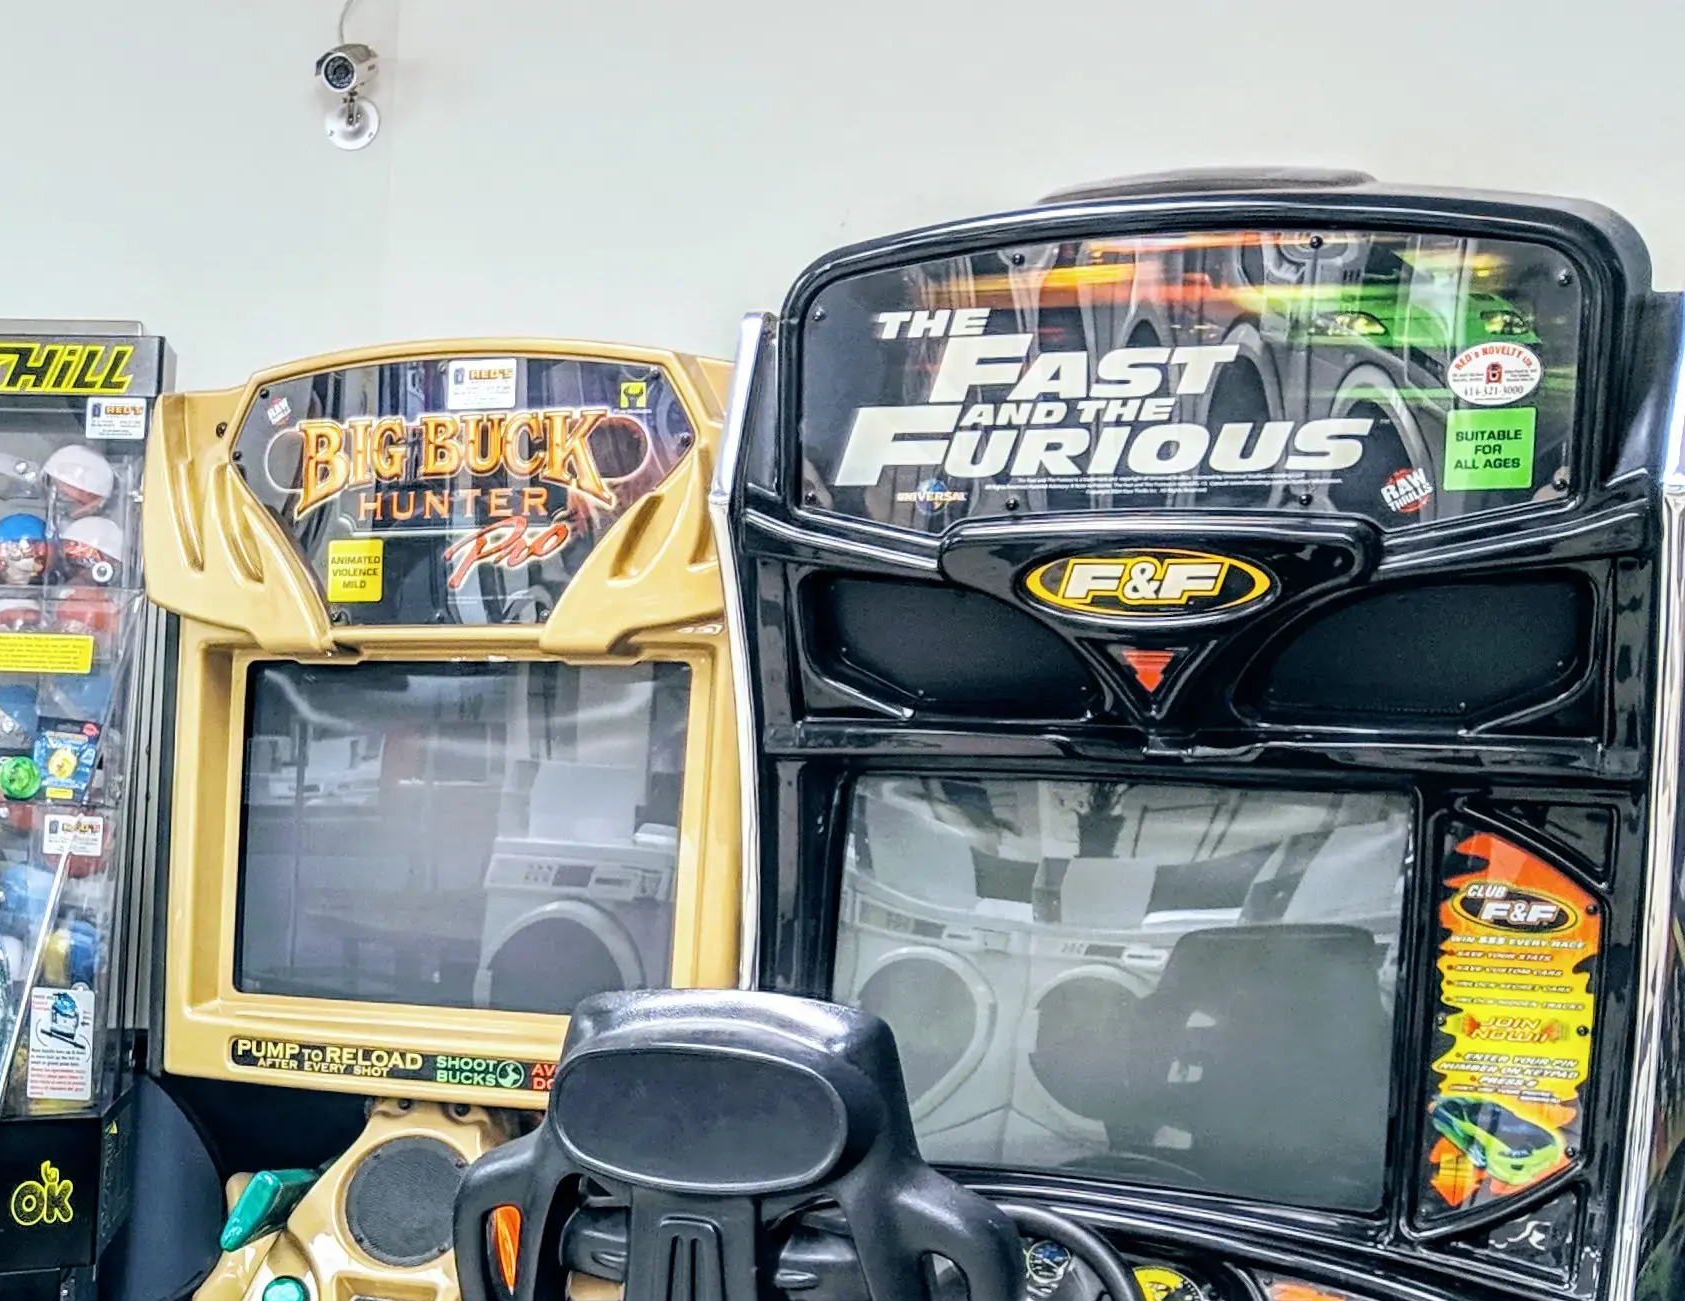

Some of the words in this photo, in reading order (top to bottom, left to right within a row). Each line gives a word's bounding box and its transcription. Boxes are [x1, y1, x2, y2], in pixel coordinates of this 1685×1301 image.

[877, 307, 991, 340] THE
[928, 332, 1241, 403] FAST
[958, 397, 1073, 424] AND
[1078, 396, 1176, 422] THE
[1454, 430, 1524, 442] SUITABLE
[834, 404, 1375, 486] FURIOUS
[1474, 444, 1503, 456] FOR
[294, 418, 412, 519] BIG
[417, 408, 616, 509] BUCK
[1454, 458, 1479, 470] ALL
[1482, 457, 1522, 470] AGES
[1381, 468, 1428, 503] RAW
[358, 487, 549, 522] HUNTER
[896, 491, 968, 502] UNIVERSAL
[330, 555, 381, 567] ANIMATED
[444, 516, 571, 591] Pro
[331, 567, 379, 579] VIOLENCE
[1061, 557, 1226, 604] F&F
[341, 579, 368, 591] MILD
[1467, 884, 1508, 898] CLUB
[1480, 901, 1558, 924] F&F
[1451, 935, 1476, 944] WIN
[1551, 940, 1586, 950] RACE
[1480, 1016, 1541, 1030] JOIN
[236, 1039, 301, 1061] PUMP
[325, 1047, 423, 1071] RELOAD
[1464, 1053, 1509, 1064] ENTER
[1512, 1055, 1550, 1066] YOUR
[257, 1057, 298, 1070] AFTER
[303, 1061, 347, 1074] EVERY
[352, 1064, 390, 1078] SHOT
[436, 1056, 499, 1072] SHOOT
[1440, 1062, 1498, 1073] NUMBER
[1524, 1067, 1580, 1079] KEYPAD
[436, 1070, 498, 1087] BUCKS
[1478, 1075, 1523, 1087] PRESS
[10, 1178, 75, 1227] OK
